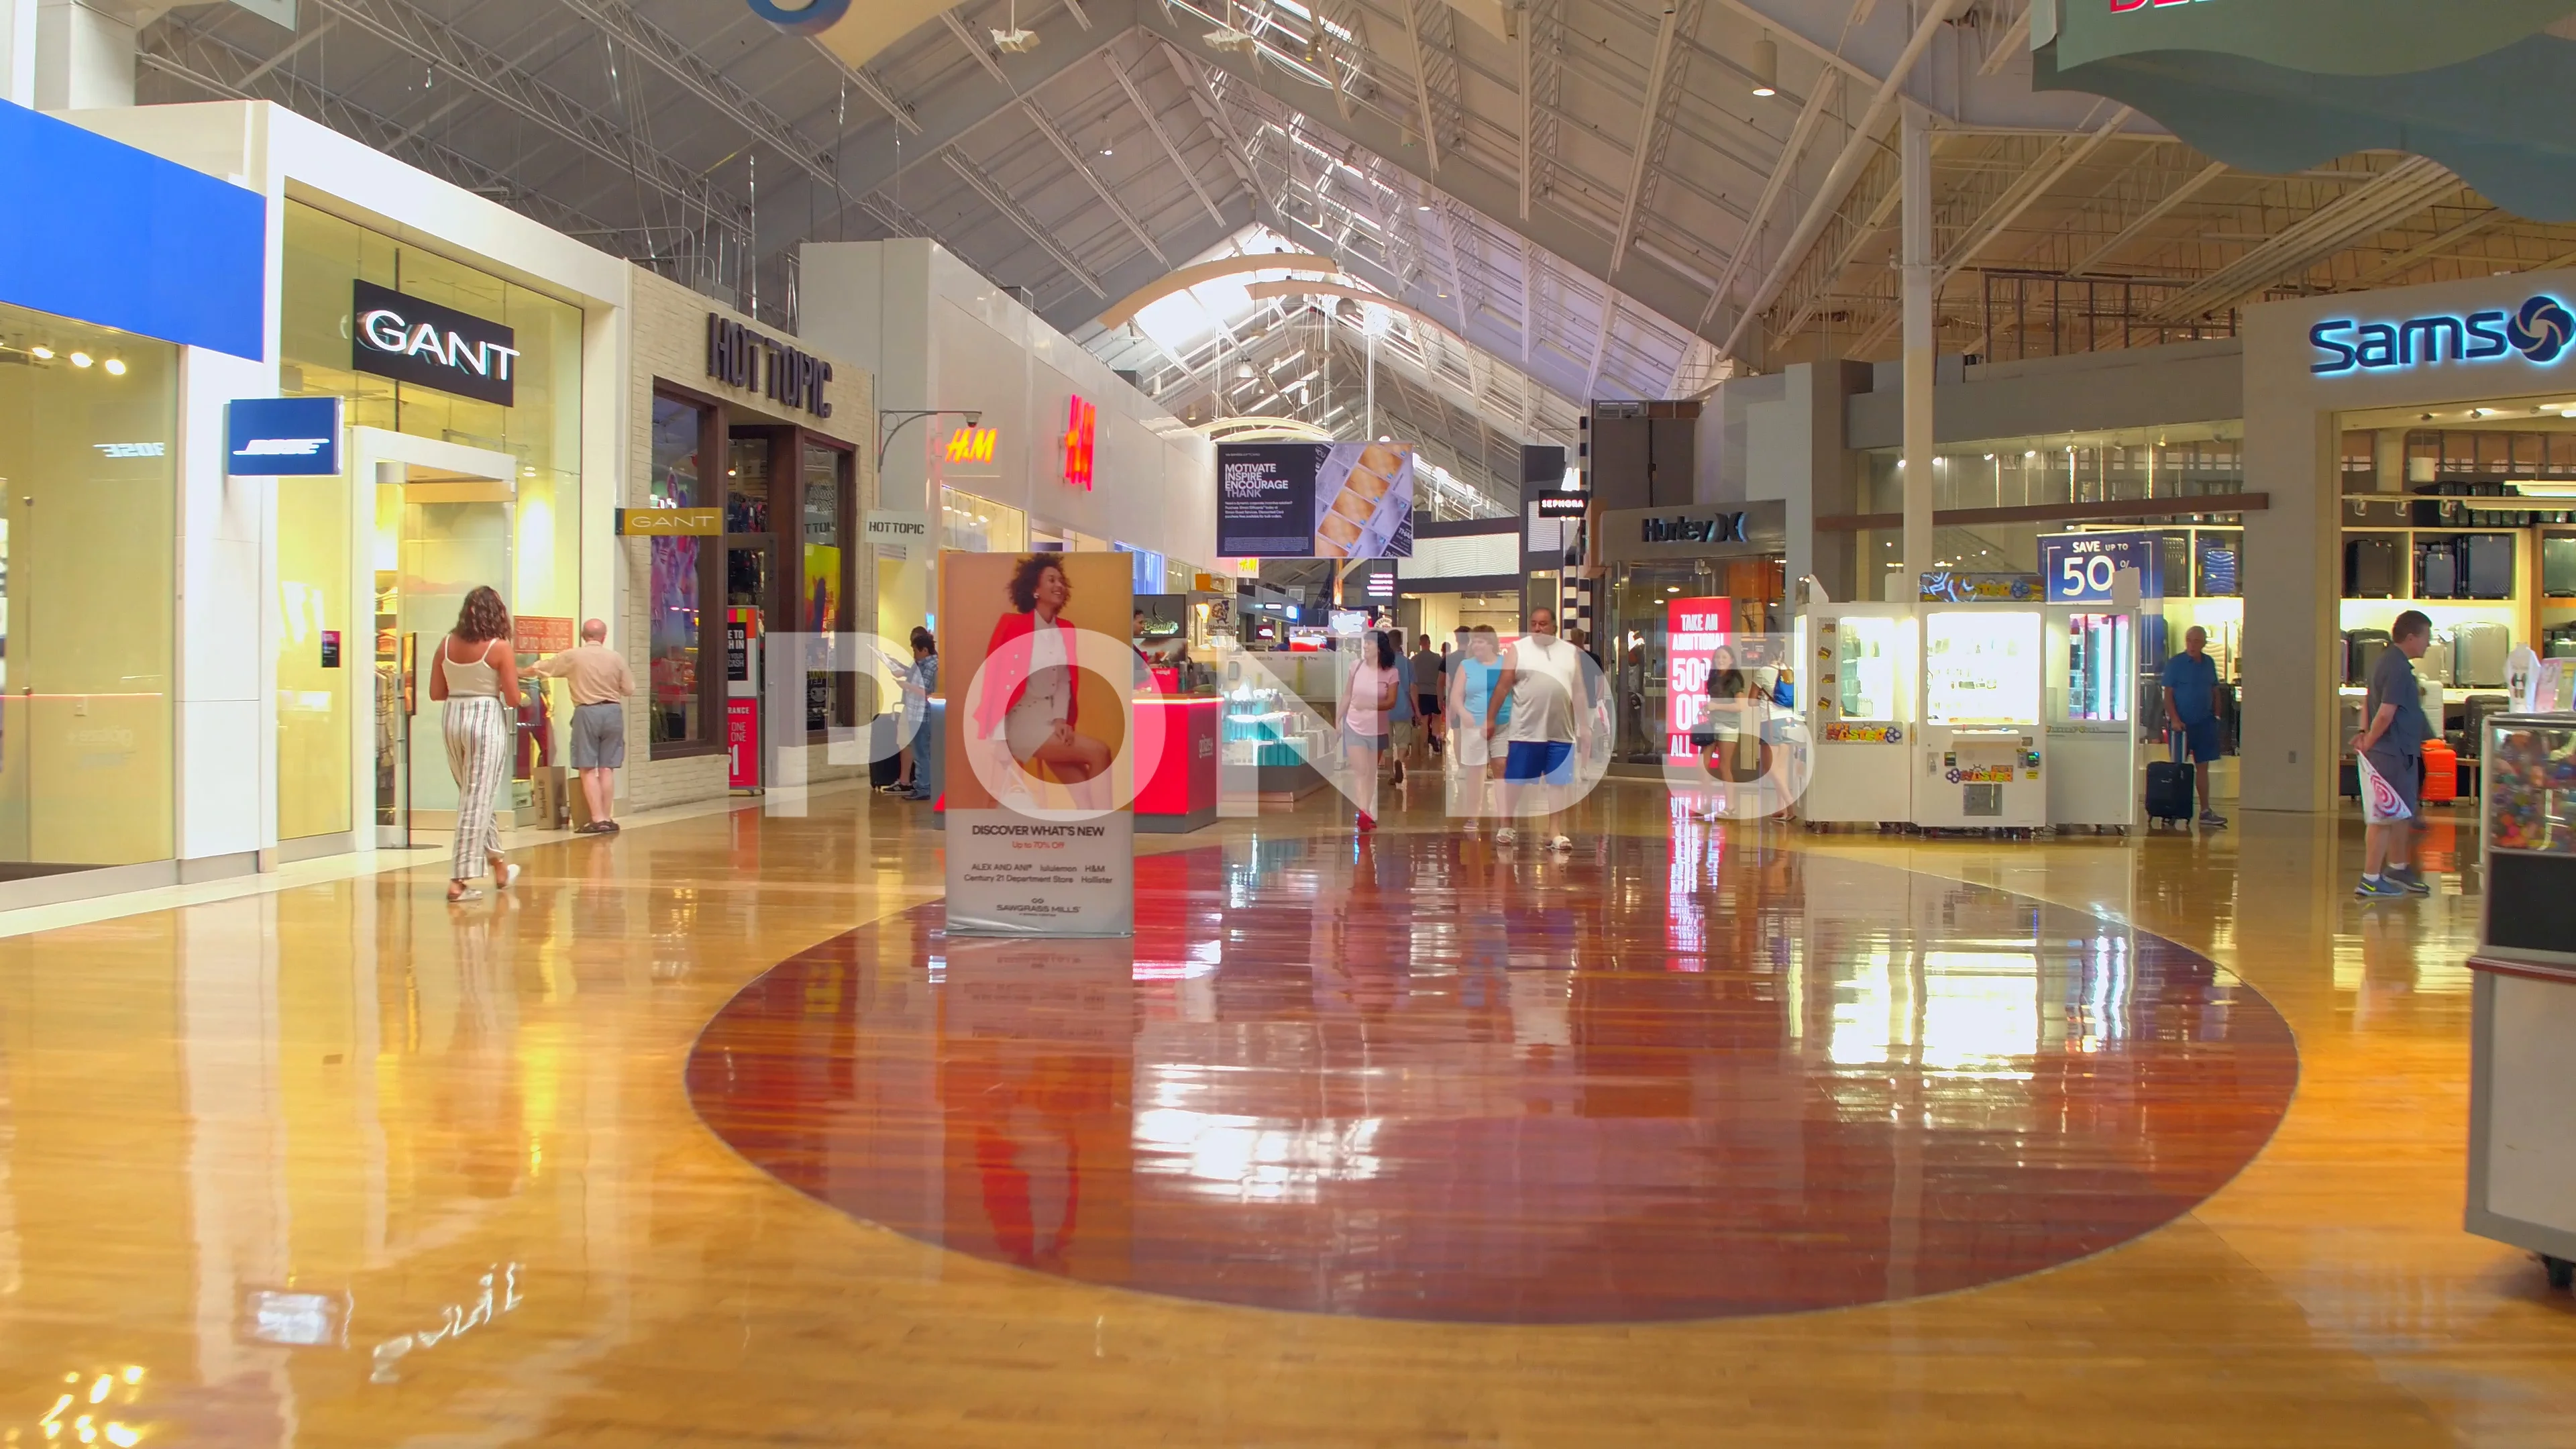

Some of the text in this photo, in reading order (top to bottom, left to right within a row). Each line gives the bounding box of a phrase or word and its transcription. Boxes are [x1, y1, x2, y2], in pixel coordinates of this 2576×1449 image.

[366, 310, 520, 380] GANT
[708, 313, 833, 419] HOT TOPIC
[1224, 464, 1277, 472] MOTIVATE
[1225, 472, 1263, 481] INSPIRE
[1225, 480, 1289, 489] ENCOURAGE
[1225, 489, 1262, 498] THANK
[1542, 499, 1584, 508] SEPHORA
[632, 516, 714, 528] GANT
[869, 521, 925, 535] HOT TOPIC
[1642, 516, 1714, 542] Hurley
[2072, 541, 2101, 553] SAVE
[2062, 555, 2115, 596] 50
[1680, 614, 1718, 632] TAKE AN
[734, 629, 745, 639] TO
[736, 639, 745, 650] IN
[1676, 694, 1711, 731] OF
[731, 722, 746, 732] ONE
[731, 732, 747, 742] ONE
[1826, 729, 1886, 741] MASTER
[1670, 735, 1693, 757] ALL
[1960, 770, 2014, 783] MASTER
[972, 825, 1105, 837] DISCOVER WHAT'S NEW
[964, 875, 994, 883] Century
[1006, 875, 1051, 883] Department
[1053, 875, 1074, 883] Store
[1081, 876, 1113, 884] Hollister
[996, 904, 1050, 912] SAWGRASS
